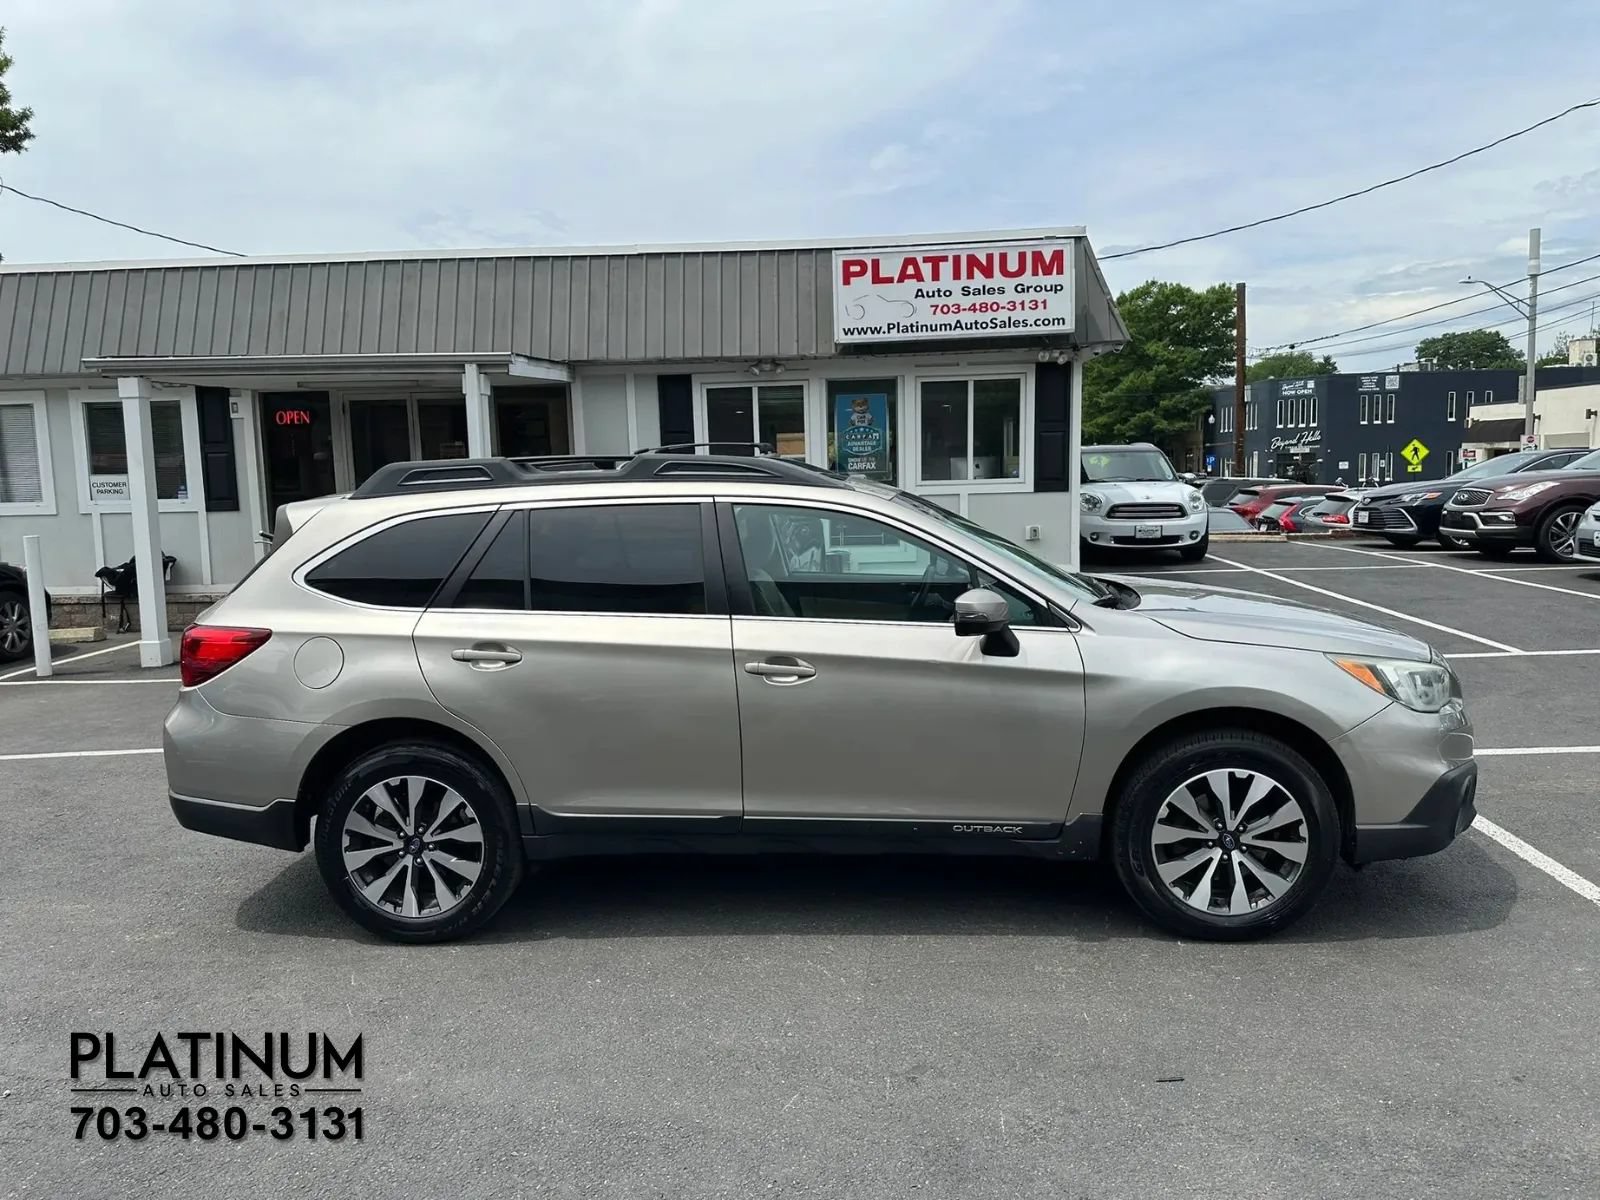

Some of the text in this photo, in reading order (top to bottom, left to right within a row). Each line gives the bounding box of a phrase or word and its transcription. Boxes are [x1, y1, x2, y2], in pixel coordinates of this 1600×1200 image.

[842, 249, 1064, 286] PLATINUM
[914, 283, 1064, 299] Auto Sales Group
[930, 299, 1048, 316] 703-480-3131
[842, 315, 1066, 336] www.PlatinumAutoSales.com
[275, 410, 310, 425] OPEN
[1270, 433, 1300, 450] Beyond
[847, 462, 876, 470] CARFAX
[91, 481, 127, 489] CUSTOMER
[952, 824, 1023, 834] OUTBACK
